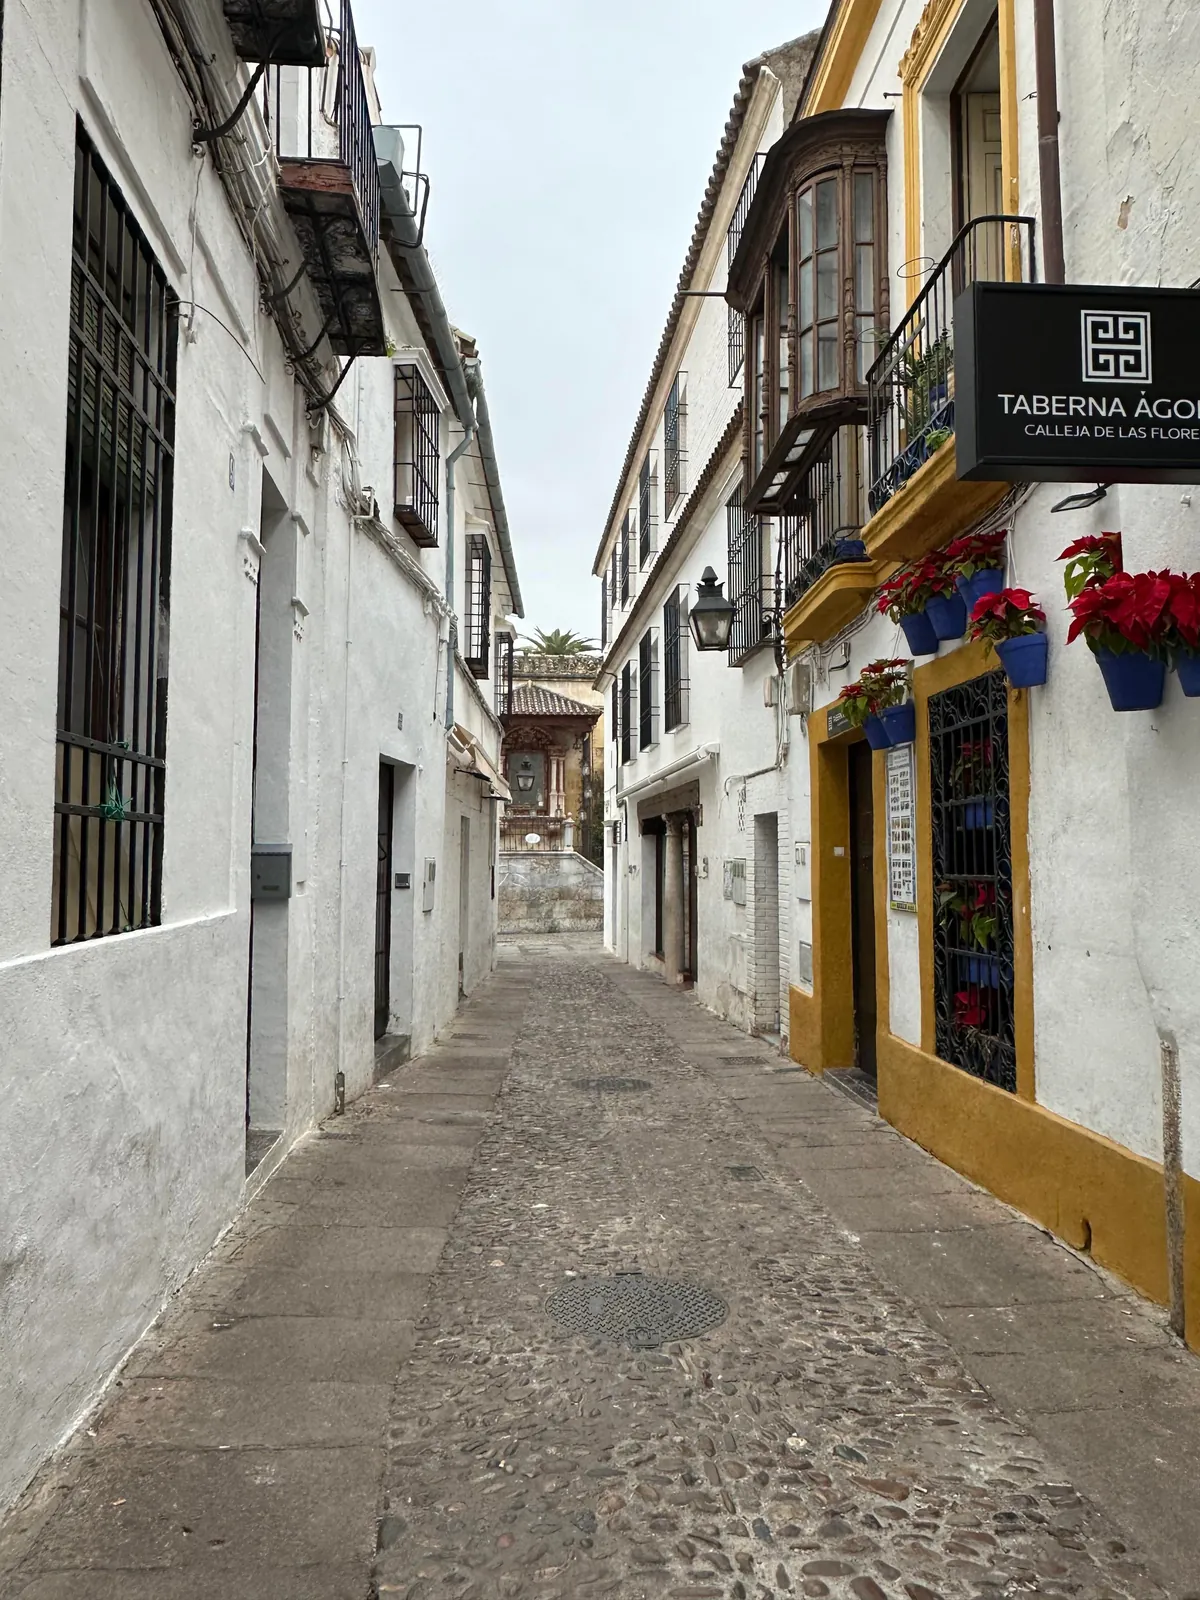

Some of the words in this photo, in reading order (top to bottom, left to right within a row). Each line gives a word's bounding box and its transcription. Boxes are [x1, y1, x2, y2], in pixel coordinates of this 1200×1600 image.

[998, 394, 1126, 417] TABERNA
[1134, 390, 1200, 419] ÁGO
[1024, 424, 1091, 437] CALLEJA
[1094, 425, 1115, 438] DE
[1118, 426, 1147, 439] LAS
[1151, 427, 1200, 440] FLORE
